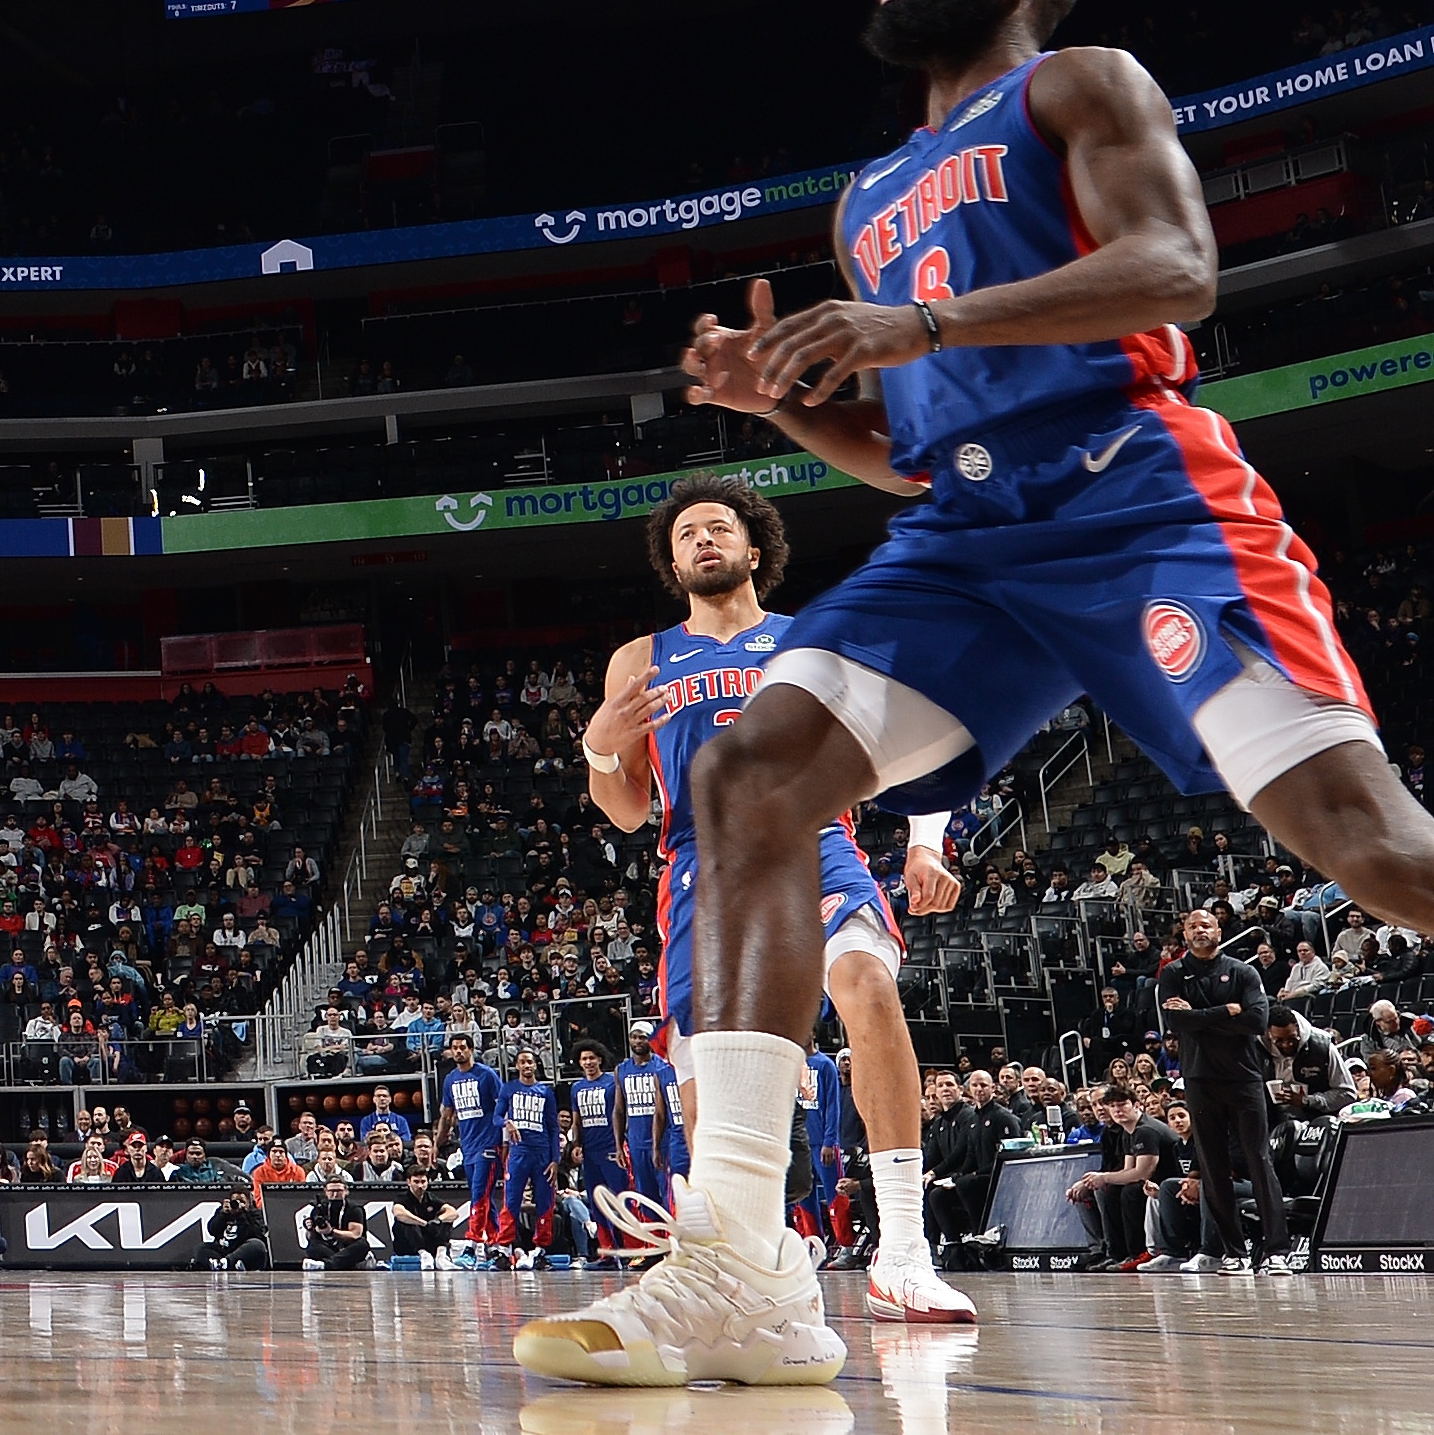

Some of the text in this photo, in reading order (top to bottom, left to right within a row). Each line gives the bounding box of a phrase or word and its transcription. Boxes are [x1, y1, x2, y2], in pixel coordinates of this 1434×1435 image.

[1203, 39, 1424, 120] YOUR HOME LOAN
[851, 144, 1009, 296] DETROIT
[1012, 1255, 1040, 1270] StockX
[1321, 1253, 1425, 1272] StockX StockX
